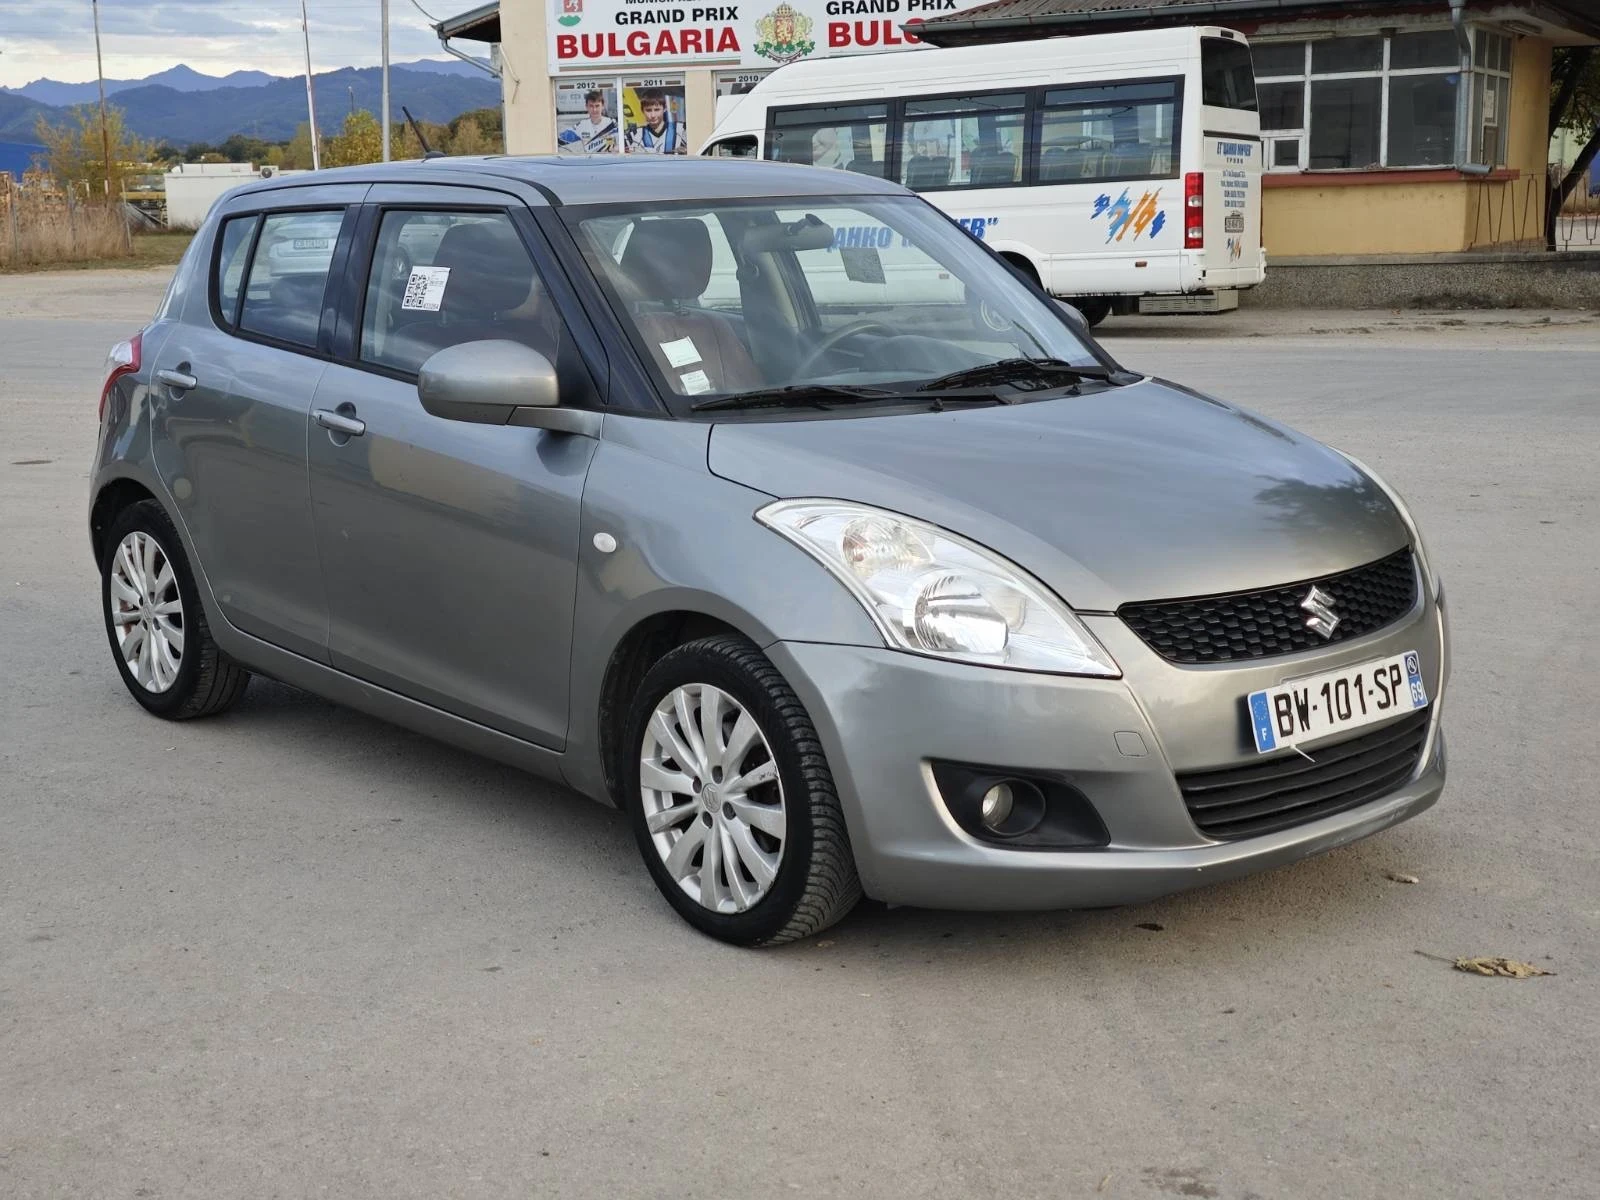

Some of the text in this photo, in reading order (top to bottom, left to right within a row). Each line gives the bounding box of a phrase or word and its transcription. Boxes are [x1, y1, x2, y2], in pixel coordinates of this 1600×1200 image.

[615, 6, 739, 26] GRAND PRIX
[826, 0, 957, 16] GRAND PRIX
[556, 27, 741, 60] BULGARIA
[576, 82, 596, 90] 2012
[643, 79, 663, 87] 2011
[738, 75, 759, 83] 2010
[1410, 680, 1424, 702] 69
[1273, 663, 1402, 738] BW-101-SP
[1261, 728, 1267, 741] F
